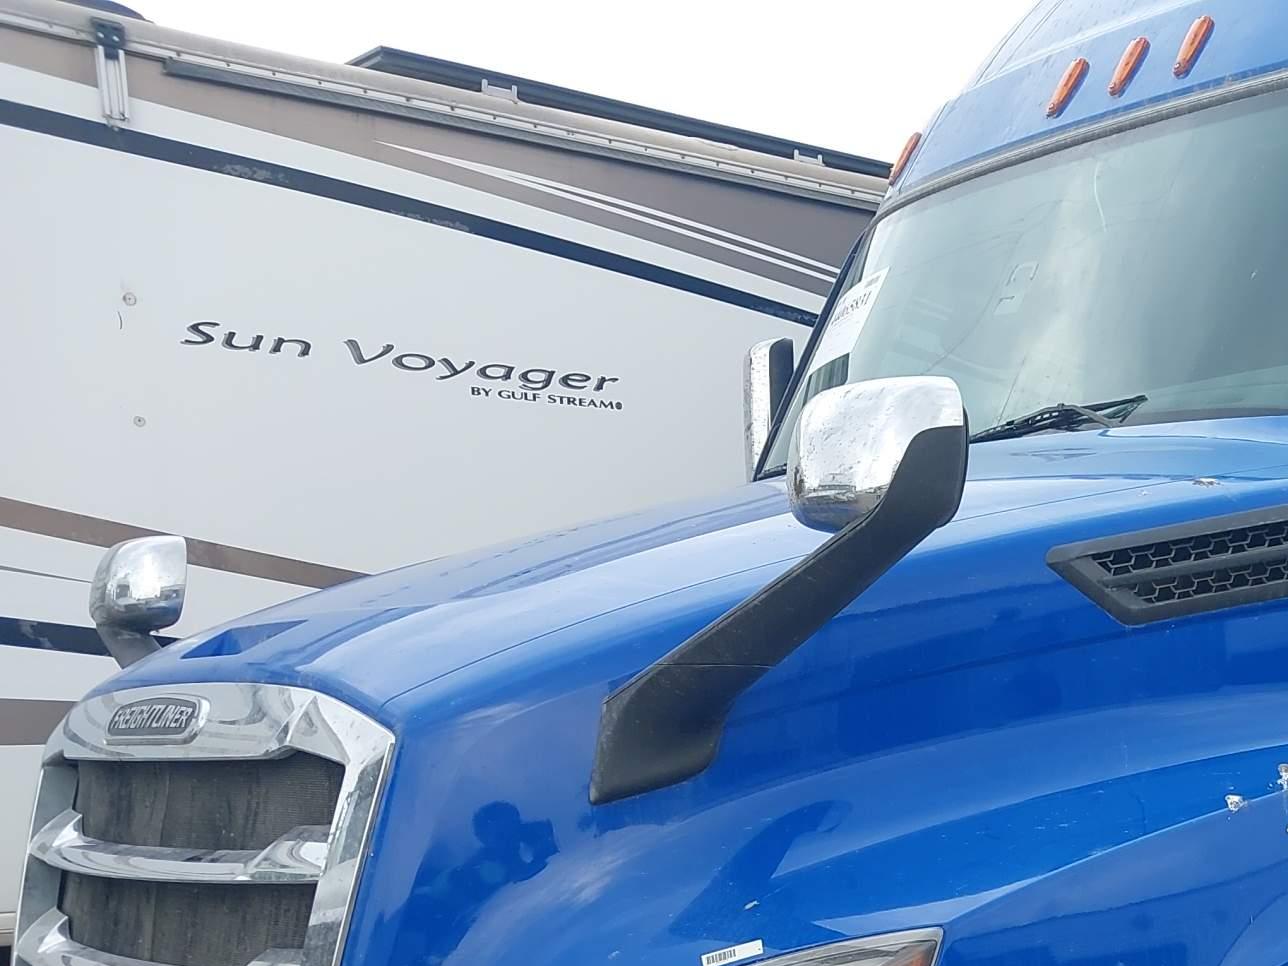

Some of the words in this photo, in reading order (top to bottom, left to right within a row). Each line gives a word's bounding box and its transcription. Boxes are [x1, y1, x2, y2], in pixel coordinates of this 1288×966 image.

[180, 321, 312, 358] Sun
[343, 338, 619, 393] Voyager
[470, 386, 492, 397] BY
[497, 389, 541, 403] GULF
[110, 704, 193, 729] FREIGHTLINER
